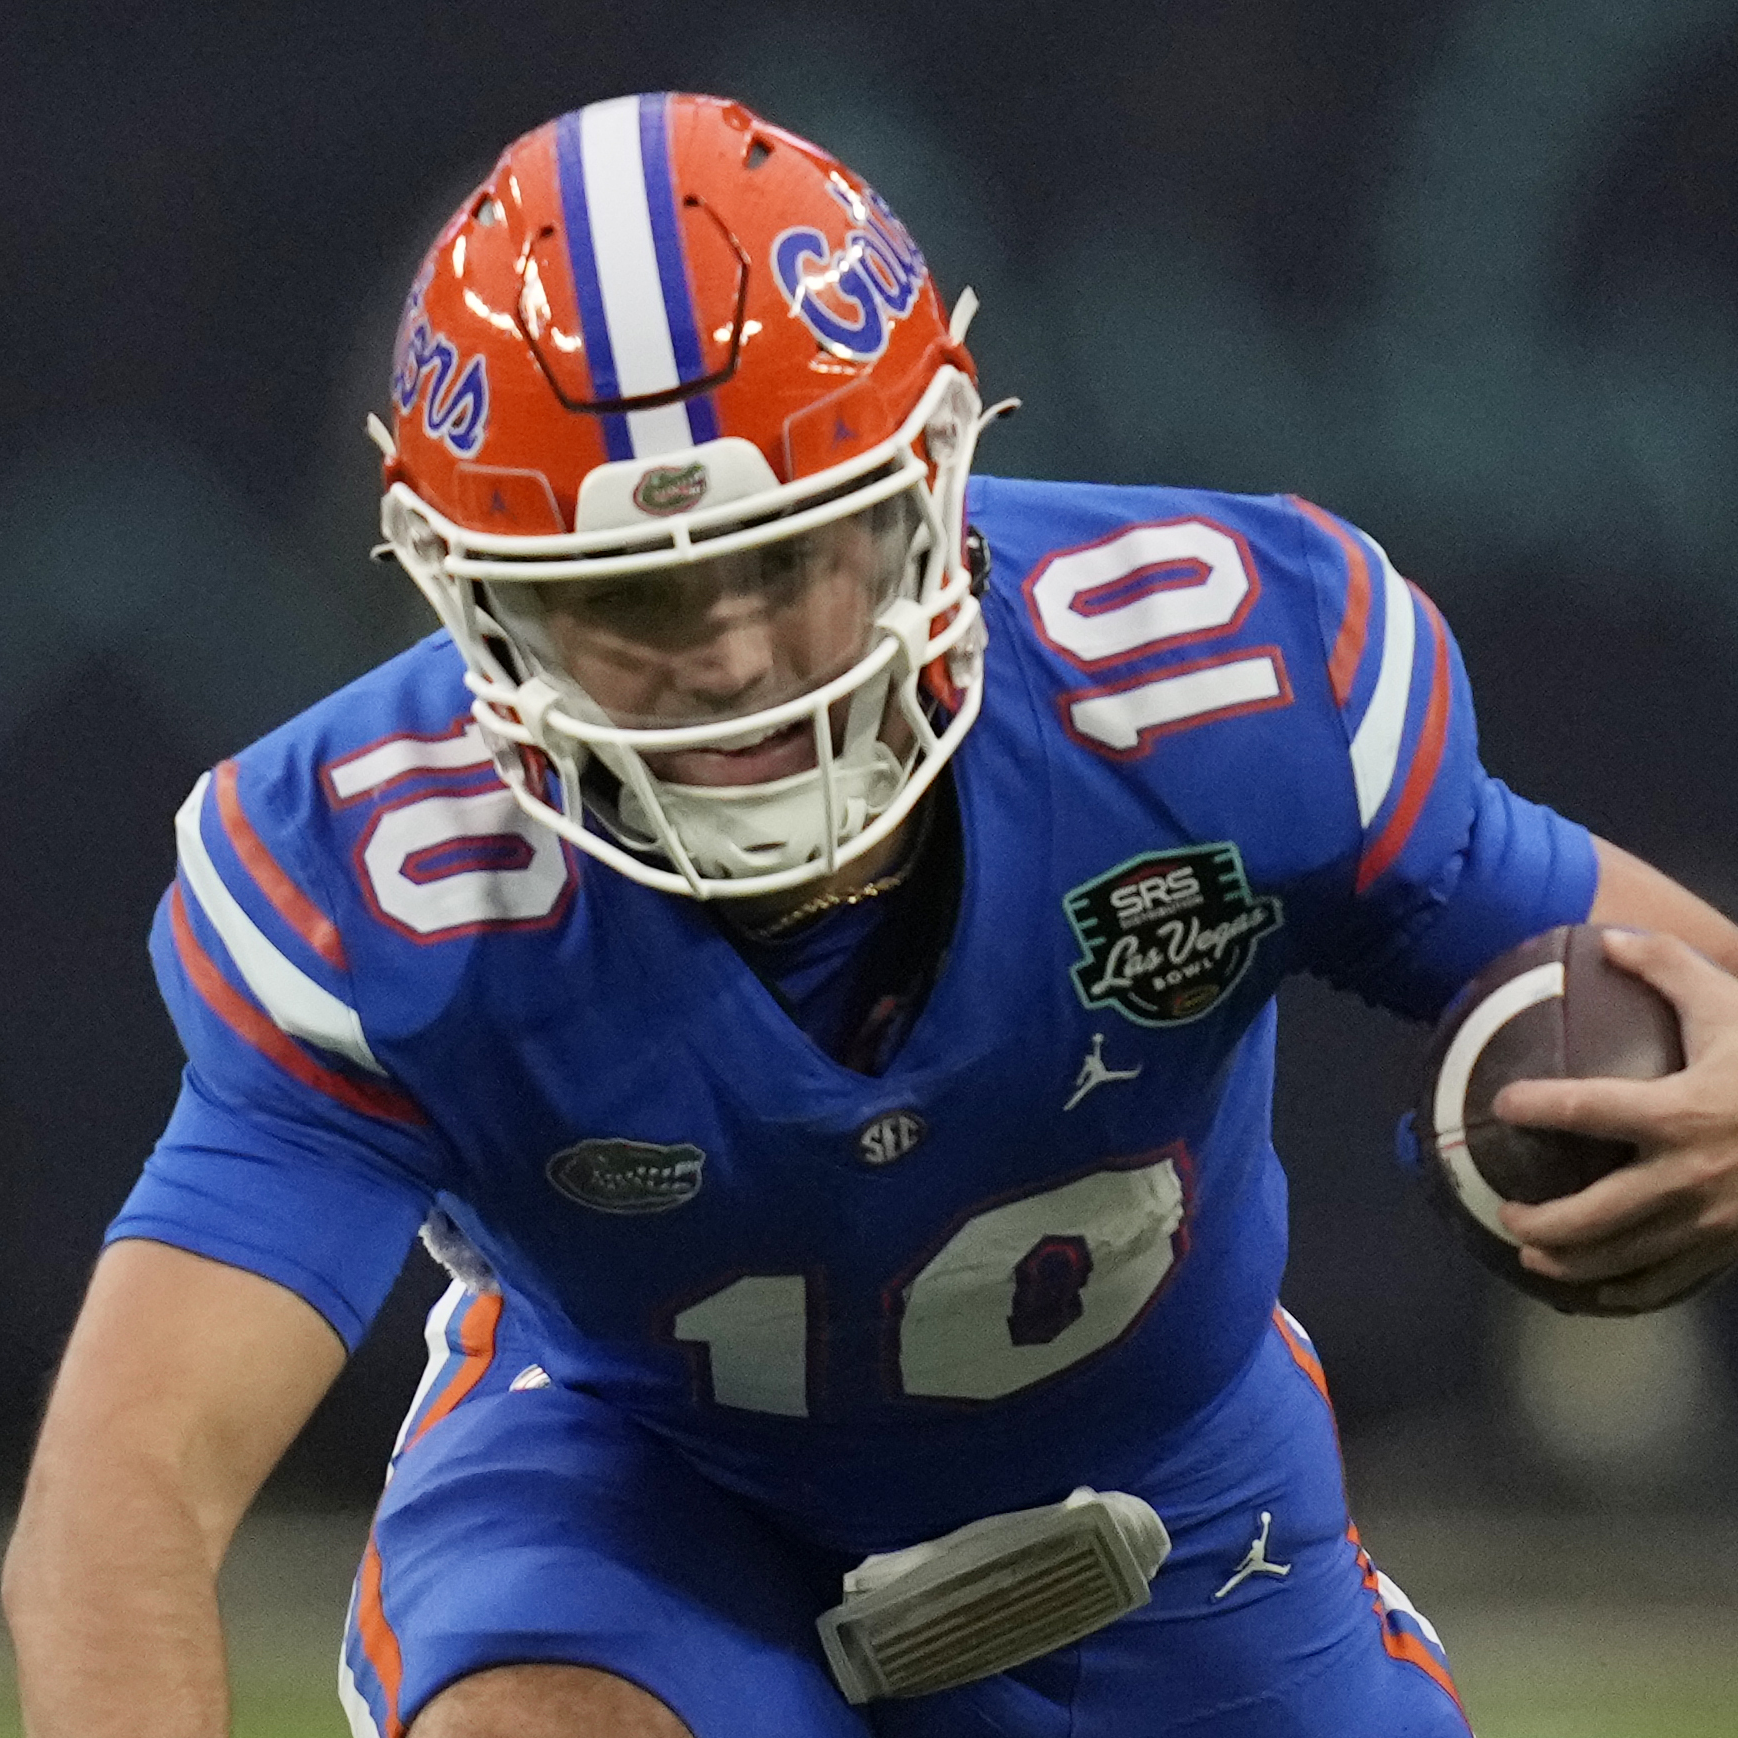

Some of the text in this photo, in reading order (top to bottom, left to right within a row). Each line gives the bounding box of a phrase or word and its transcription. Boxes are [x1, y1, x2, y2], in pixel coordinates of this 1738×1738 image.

[1022, 515, 1294, 762] 10
[321, 716, 580, 947] 10
[1110, 865, 1202, 919] SRS
[1090, 934, 1163, 996] Las
[1155, 907, 1268, 961] Vegas
[861, 1114, 921, 1164] SEC
[658, 1143, 1194, 1419] 10
